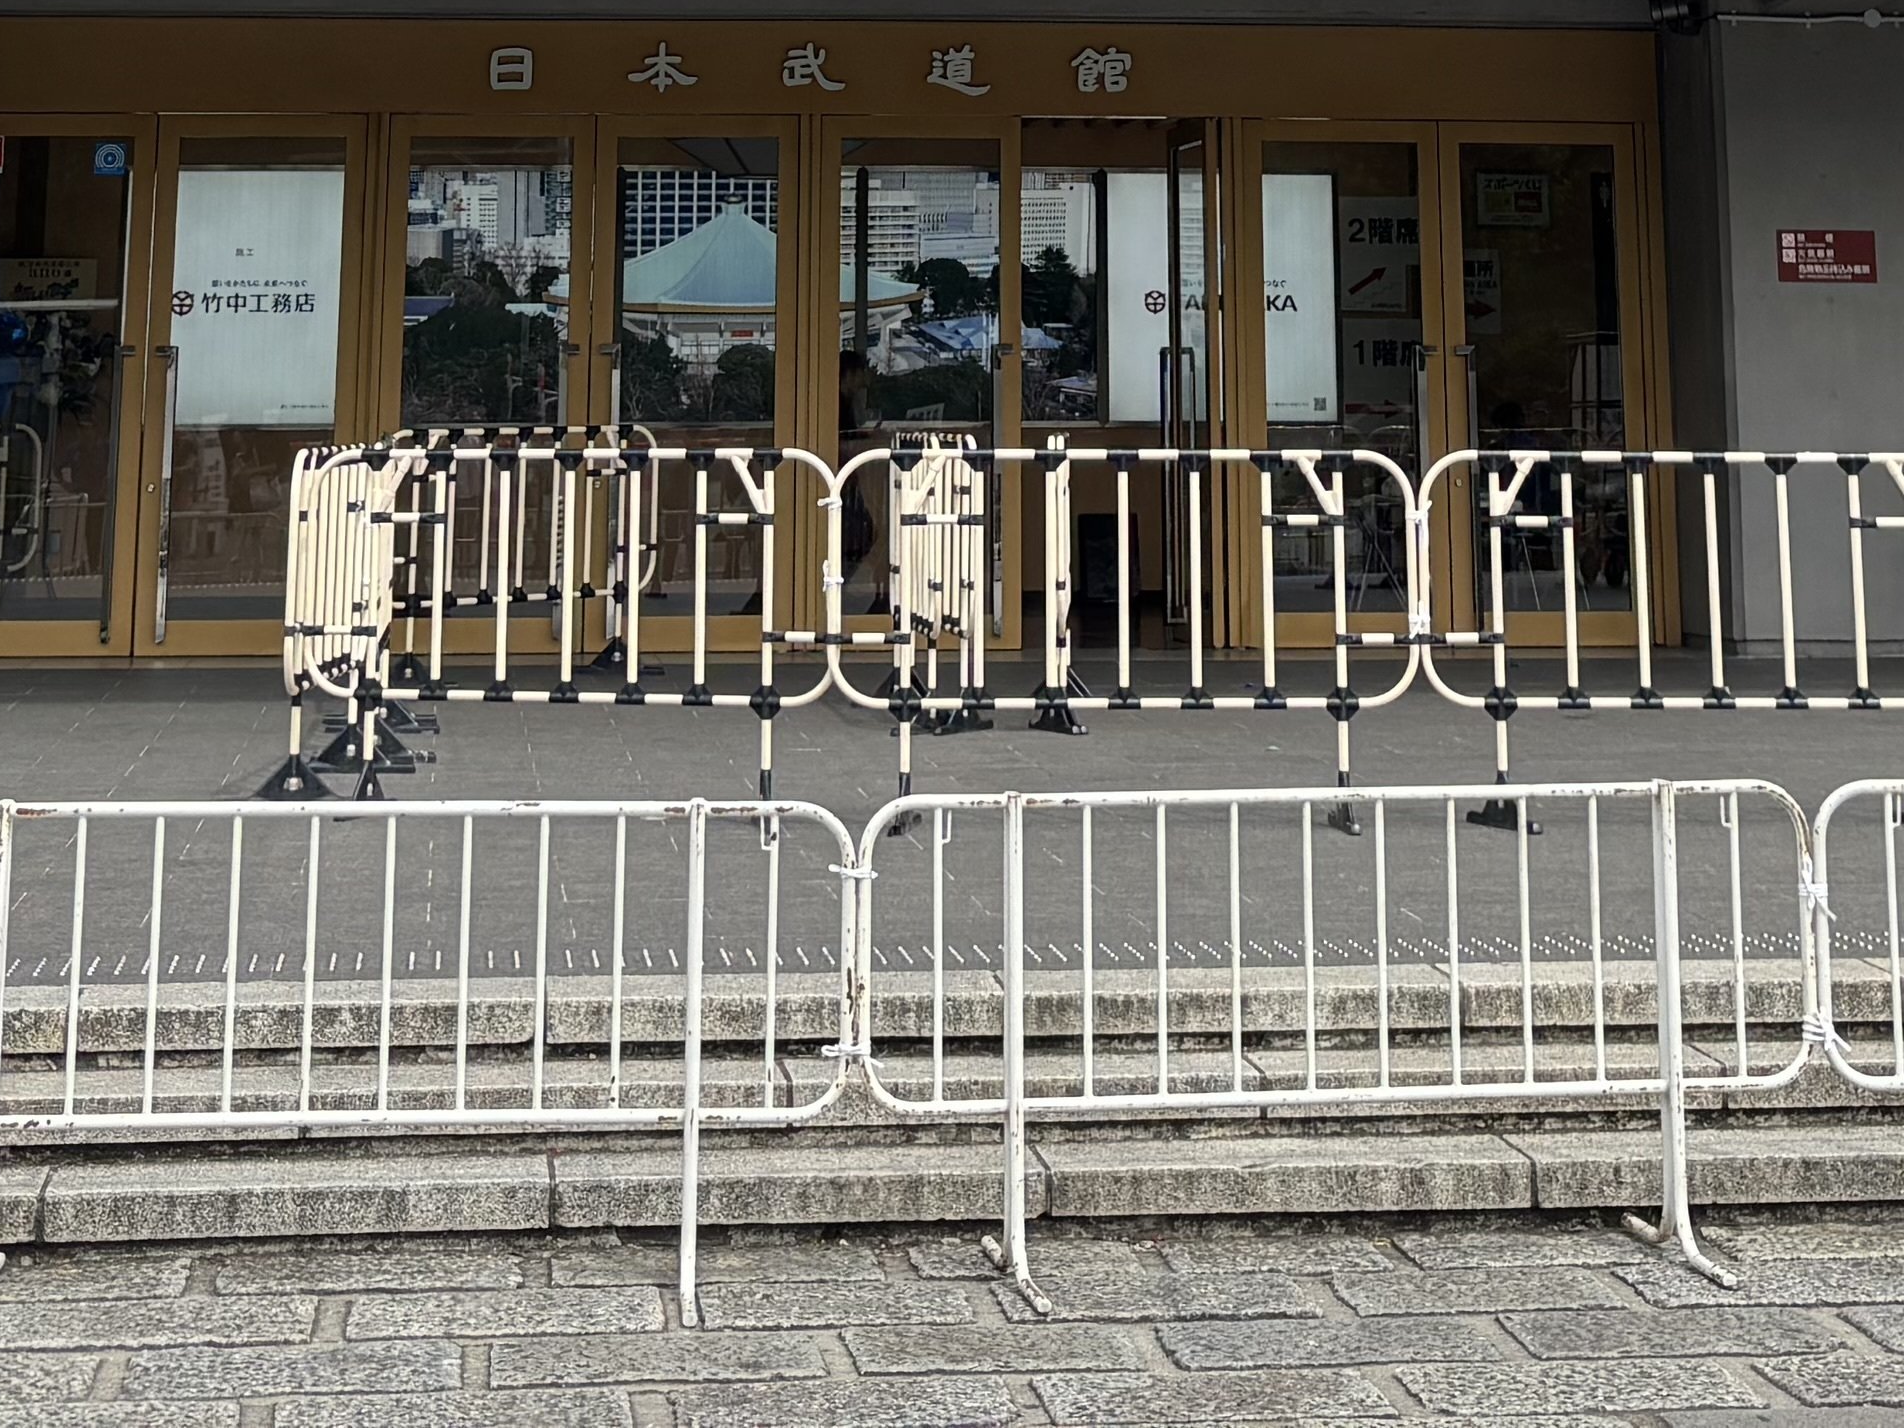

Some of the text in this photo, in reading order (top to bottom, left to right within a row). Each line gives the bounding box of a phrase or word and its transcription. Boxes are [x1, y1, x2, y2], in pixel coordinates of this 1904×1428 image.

[489, 41, 1132, 94] 日本武道館
[201, 292, 315, 314] 竹中工務店
